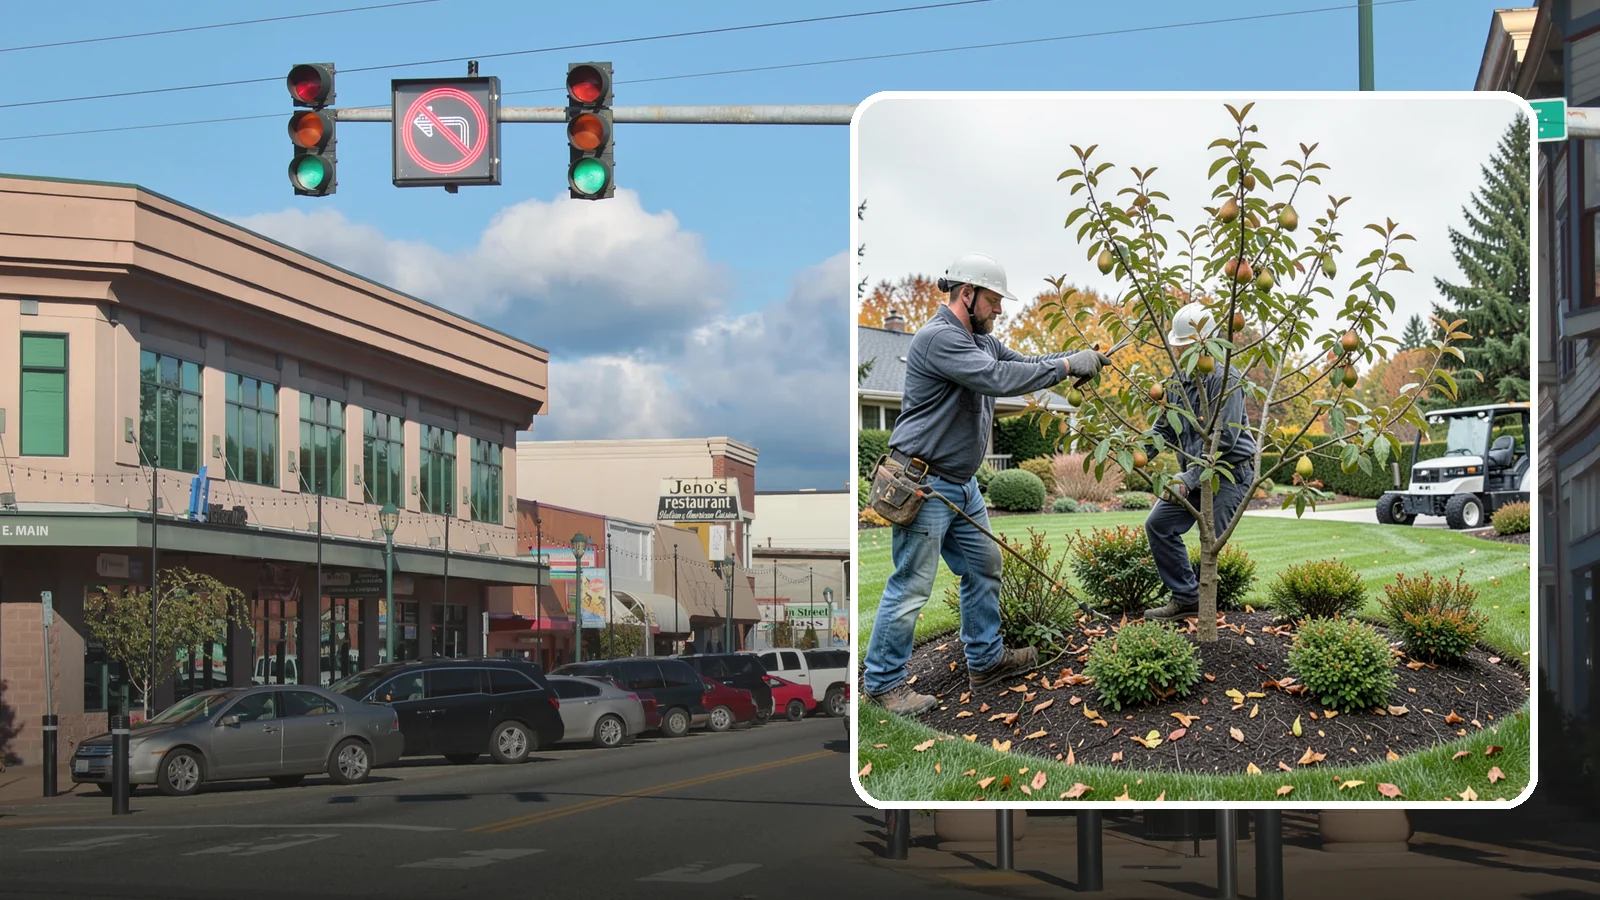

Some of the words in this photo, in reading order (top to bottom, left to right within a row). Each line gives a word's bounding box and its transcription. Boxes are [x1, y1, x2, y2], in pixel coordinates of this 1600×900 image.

[670, 480, 727, 494] Jeno's
[665, 496, 731, 509] restaurant
[686, 510, 714, 519] American
[715, 509, 737, 519] Cuisine
[2, 525, 13, 536] E.
[16, 525, 49, 536] MAIN
[797, 607, 828, 616] Street
